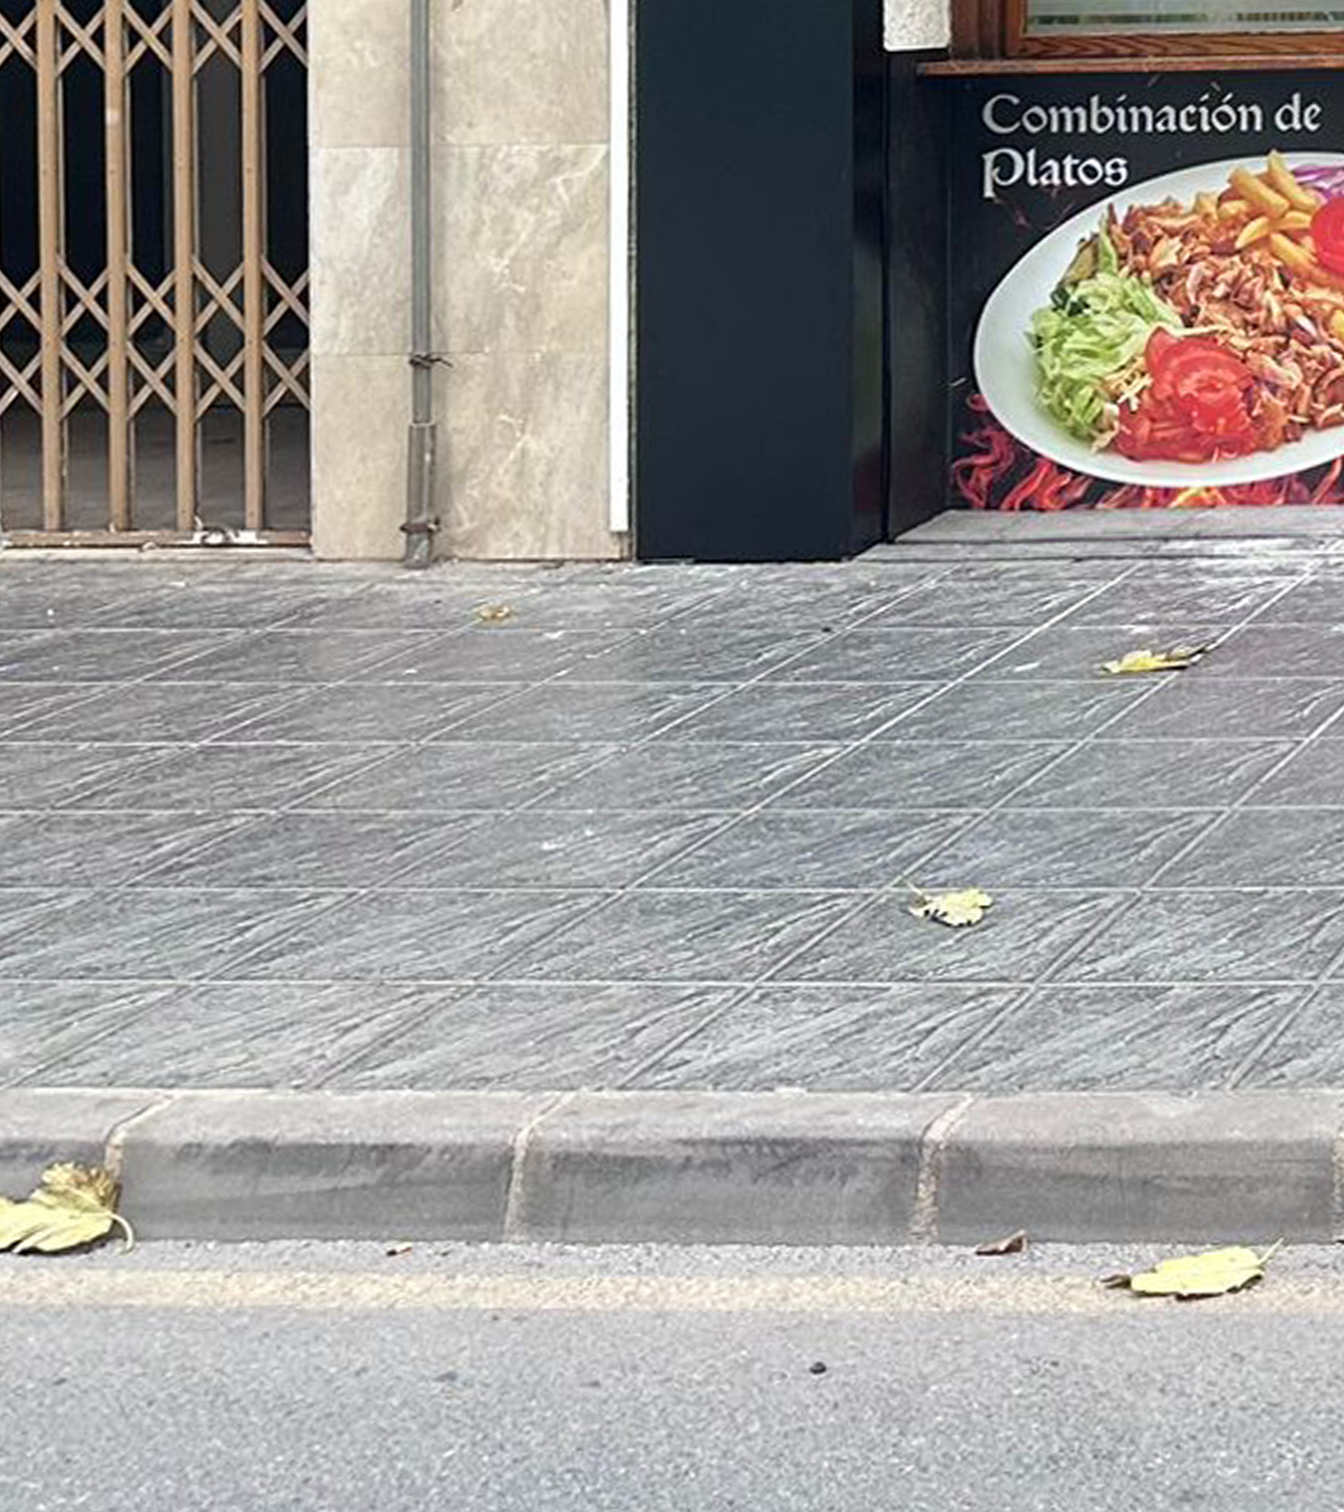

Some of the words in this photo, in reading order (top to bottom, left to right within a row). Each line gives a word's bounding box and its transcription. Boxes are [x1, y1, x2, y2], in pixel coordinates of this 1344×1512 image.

[982, 92, 1264, 134] Combinación
[1274, 92, 1322, 133] de
[982, 146, 1129, 198] Platos
